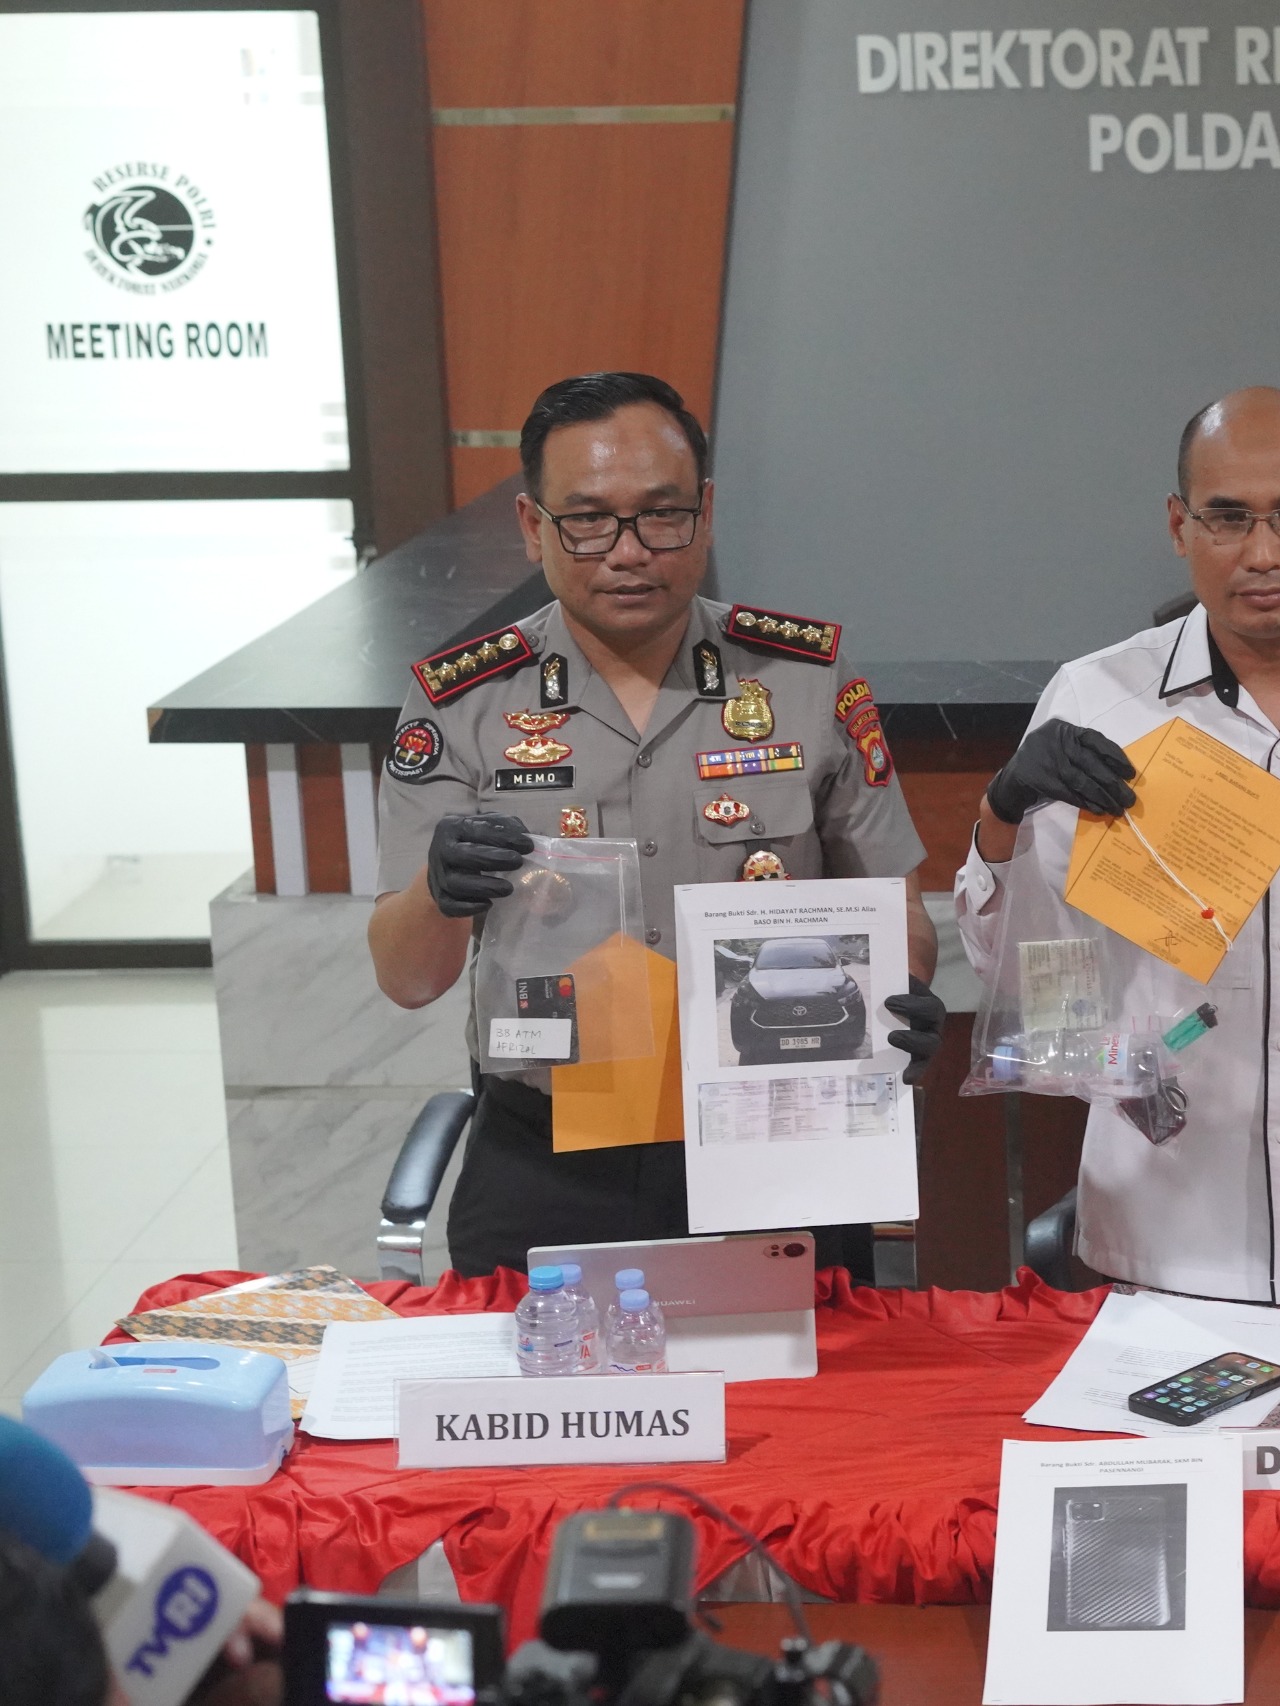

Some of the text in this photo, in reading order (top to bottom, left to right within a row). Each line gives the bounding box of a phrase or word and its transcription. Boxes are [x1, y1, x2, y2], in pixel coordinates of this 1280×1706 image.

[856, 26, 1209, 93] DIREKTORAT
[92, 161, 216, 229] RESERSE POLRI
[46, 321, 269, 359] MEETING ROOM
[513, 773, 556, 784] MEMO
[518, 981, 528, 1000] BNI
[435, 1409, 690, 1442] KABID HUMAS
